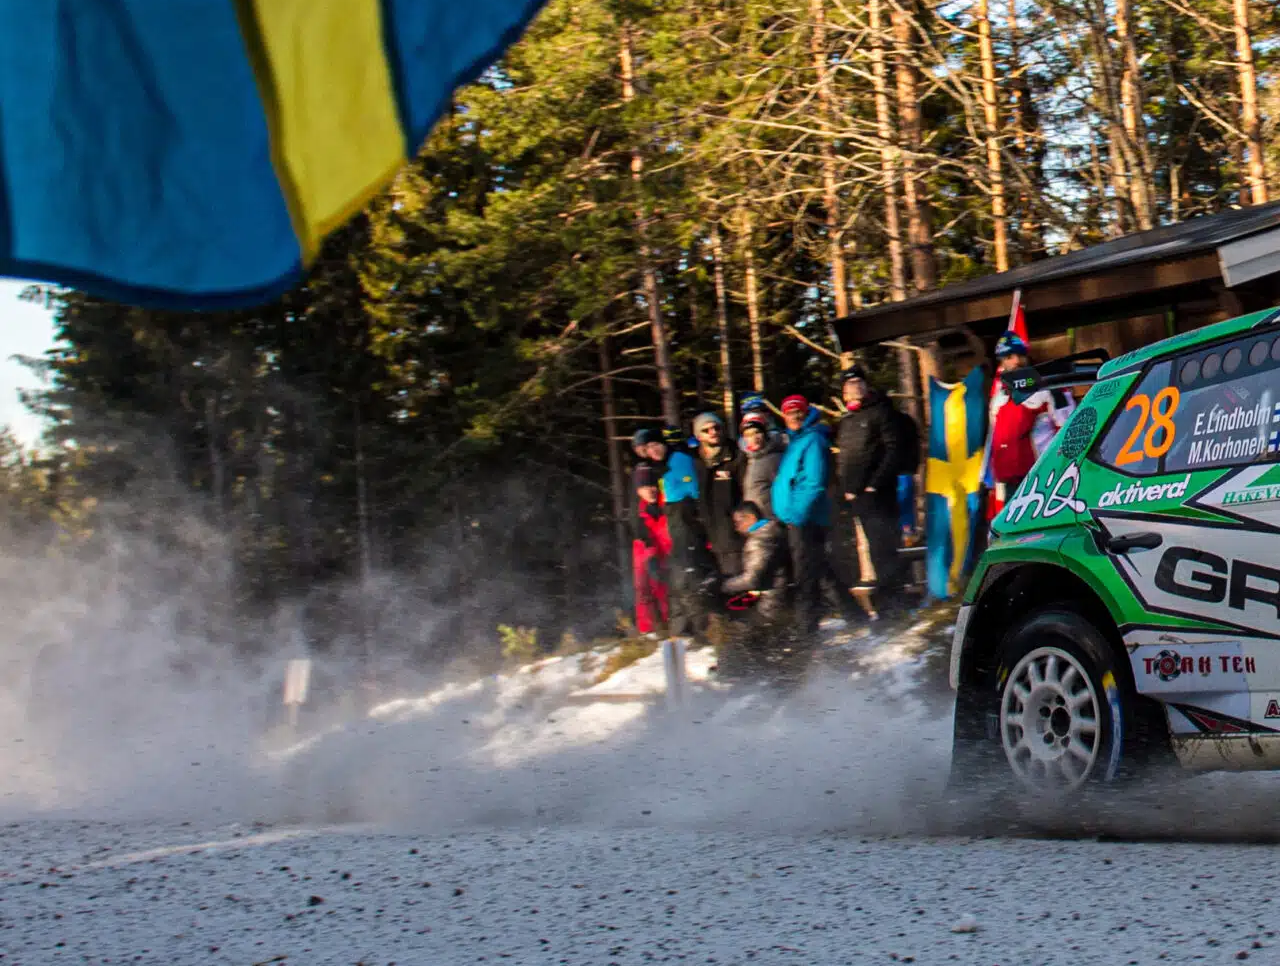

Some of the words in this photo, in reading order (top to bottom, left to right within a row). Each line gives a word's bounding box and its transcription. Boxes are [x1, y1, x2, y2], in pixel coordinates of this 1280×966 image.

[1115, 386, 1180, 466] 28
[1193, 403, 1271, 436] E.Lindholm
[1187, 436, 1266, 465] M.Korhonen
[1098, 473, 1192, 508] aktivera!
